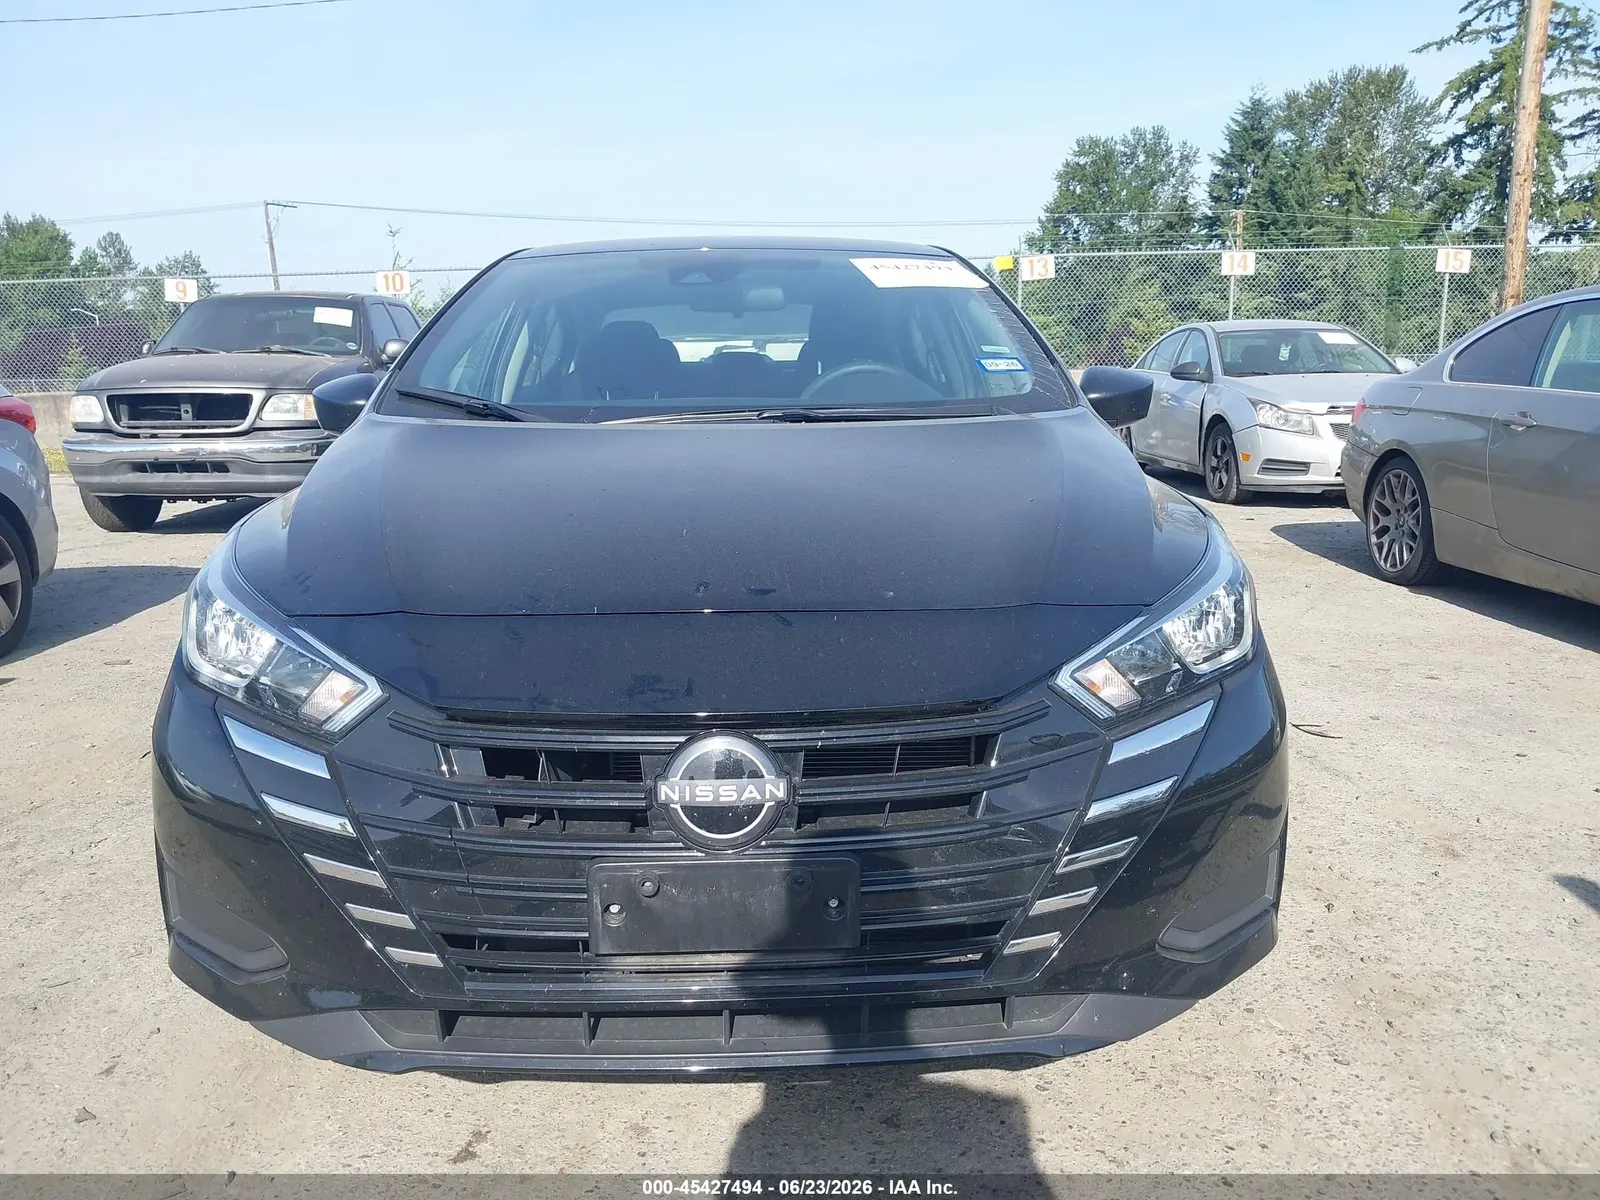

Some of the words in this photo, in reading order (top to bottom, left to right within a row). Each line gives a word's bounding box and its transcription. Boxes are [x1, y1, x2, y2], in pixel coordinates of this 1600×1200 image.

[1028, 257, 1049, 277] 13
[1229, 254, 1249, 272] 14
[1444, 250, 1464, 271] 15
[175, 280, 187, 300] 9
[383, 272, 404, 292] 10
[984, 360, 1019, 369] 09-26
[659, 781, 784, 802] NISSAN
